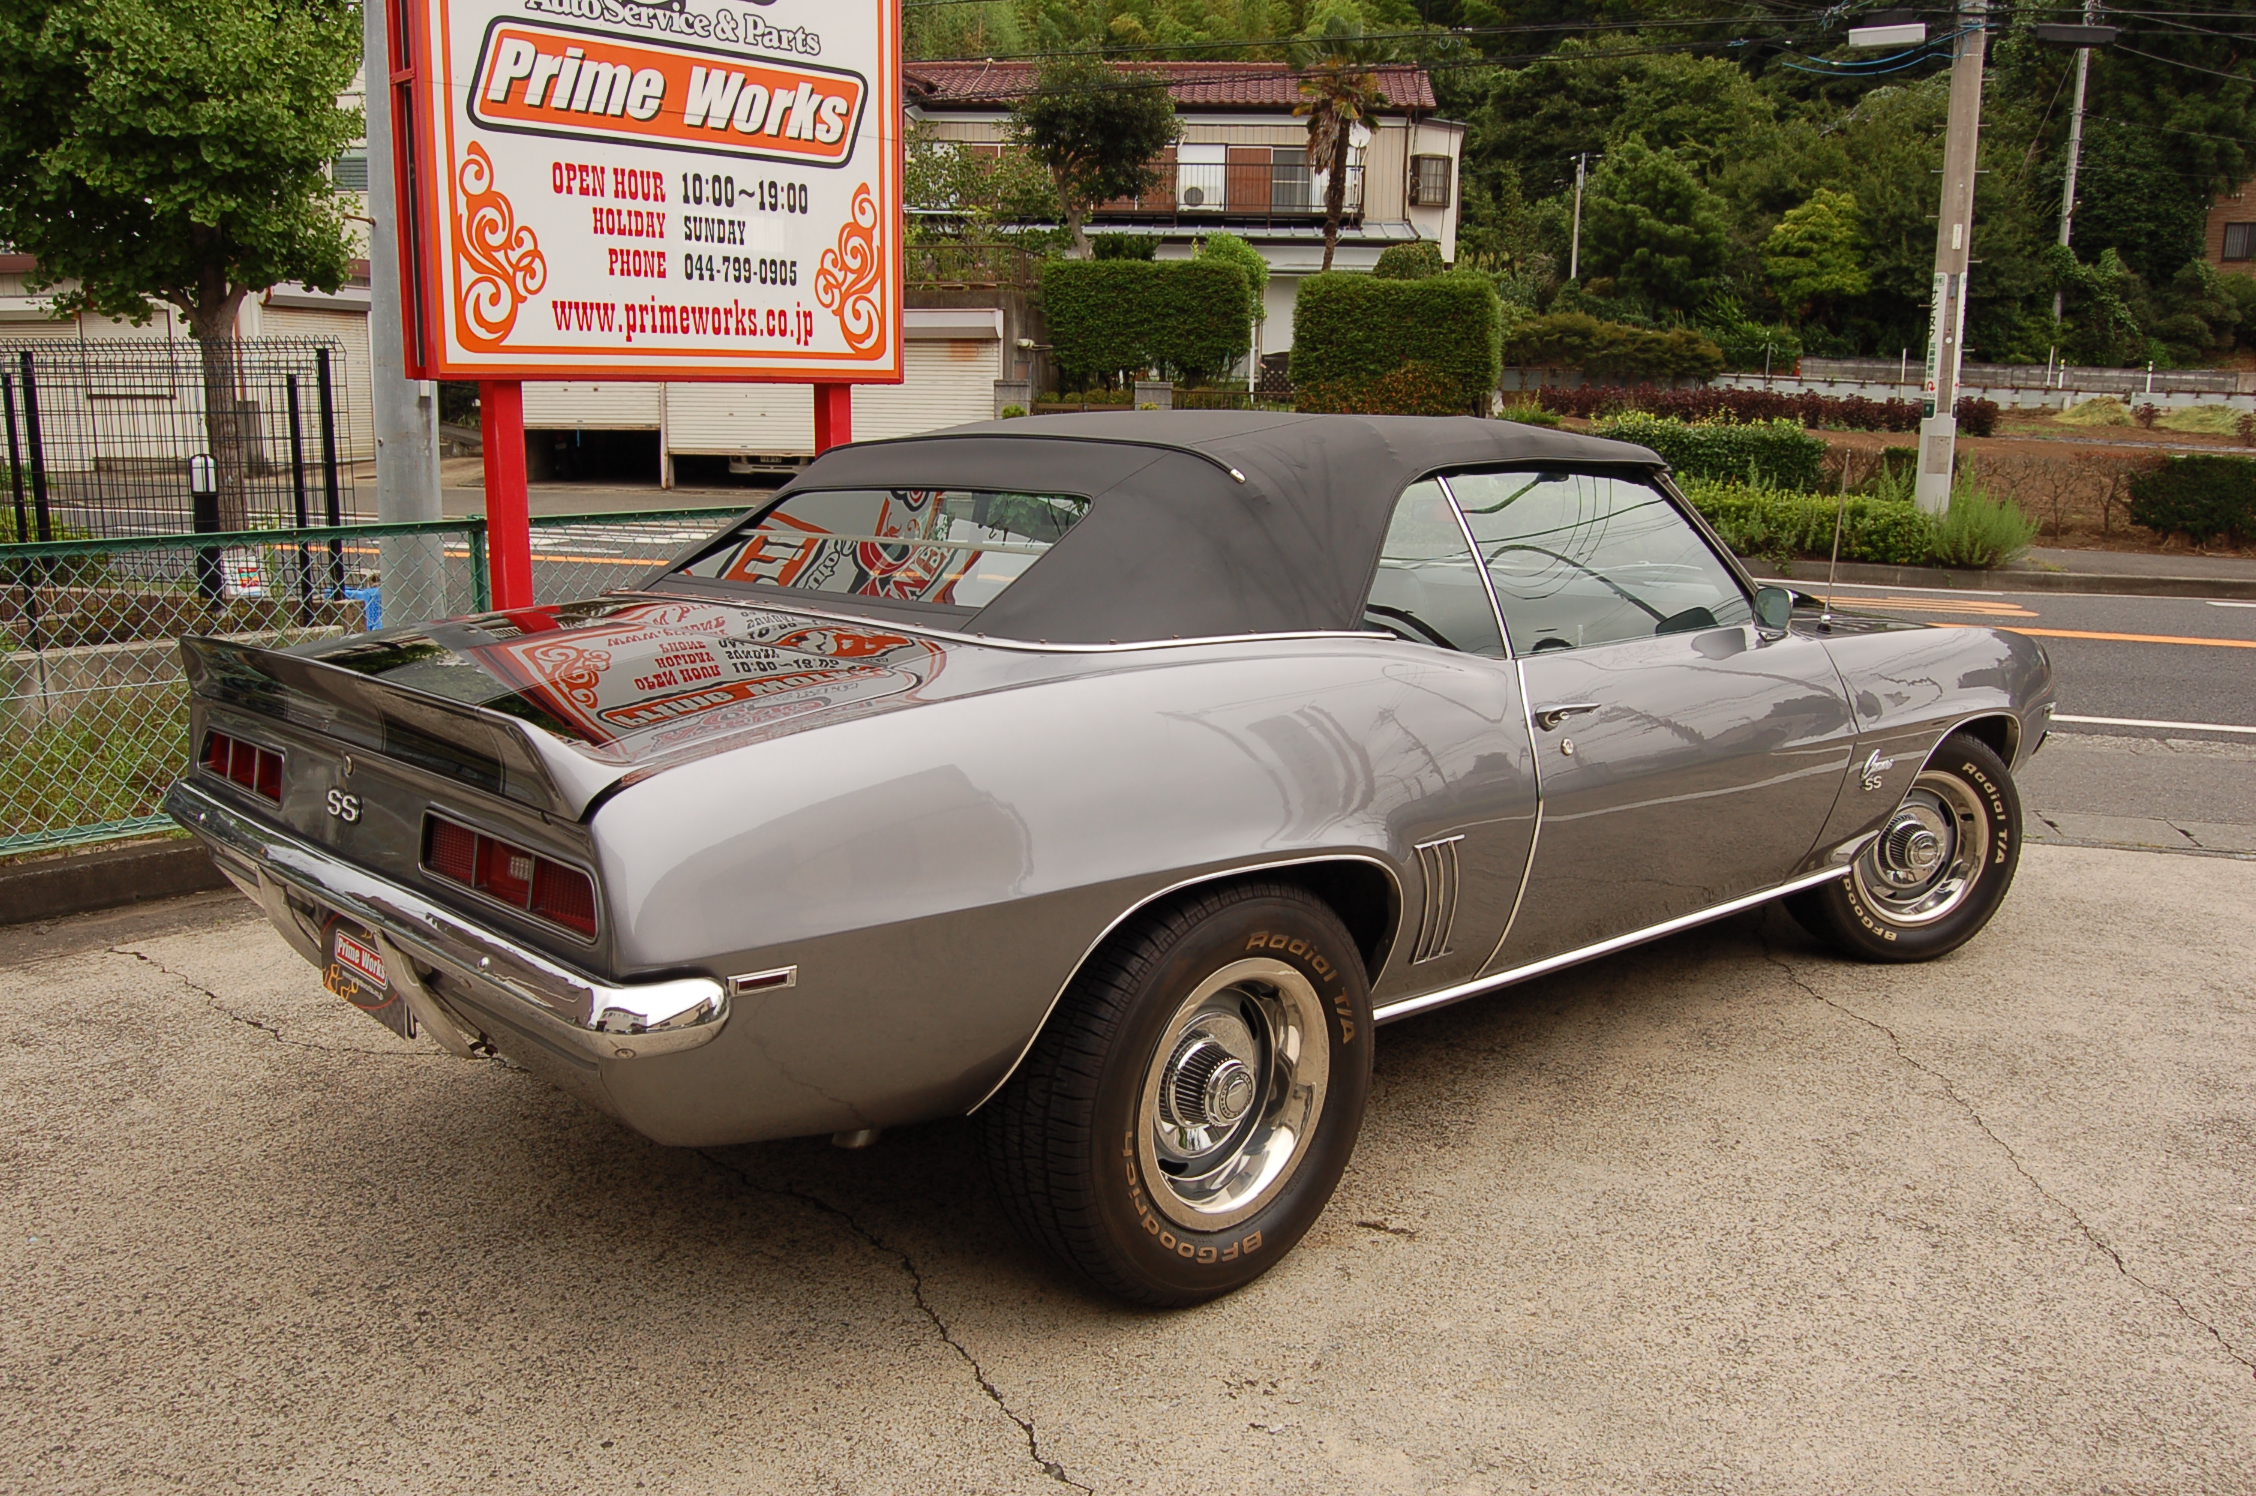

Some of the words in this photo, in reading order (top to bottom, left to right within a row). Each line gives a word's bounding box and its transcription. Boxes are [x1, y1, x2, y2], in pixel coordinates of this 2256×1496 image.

[713, 8, 739, 43] &
[743, 13, 821, 56] Parts
[486, 37, 667, 122] Prime
[683, 66, 850, 145] Works
[552, 161, 606, 198] OPEN
[613, 167, 666, 203] HOUR
[592, 207, 666, 239] HOLIDAY
[684, 215, 746, 246] SUNDAY
[608, 248, 667, 279] PHONE
[684, 253, 798, 287] 044-799-0905
[552, 295, 814, 347] www.primeworks.co.jp
[327, 789, 359, 822] SS
[1864, 775, 1882, 791] SS
[1962, 762, 2007, 821] Radial
[1994, 829, 2008, 865] T/A
[336, 936, 361, 965] Prime
[361, 949, 387, 980] Works
[1246, 930, 1339, 983] Radial
[1333, 986, 1358, 1046] T/A
[1122, 1130, 1263, 1265] BFGoodrich
